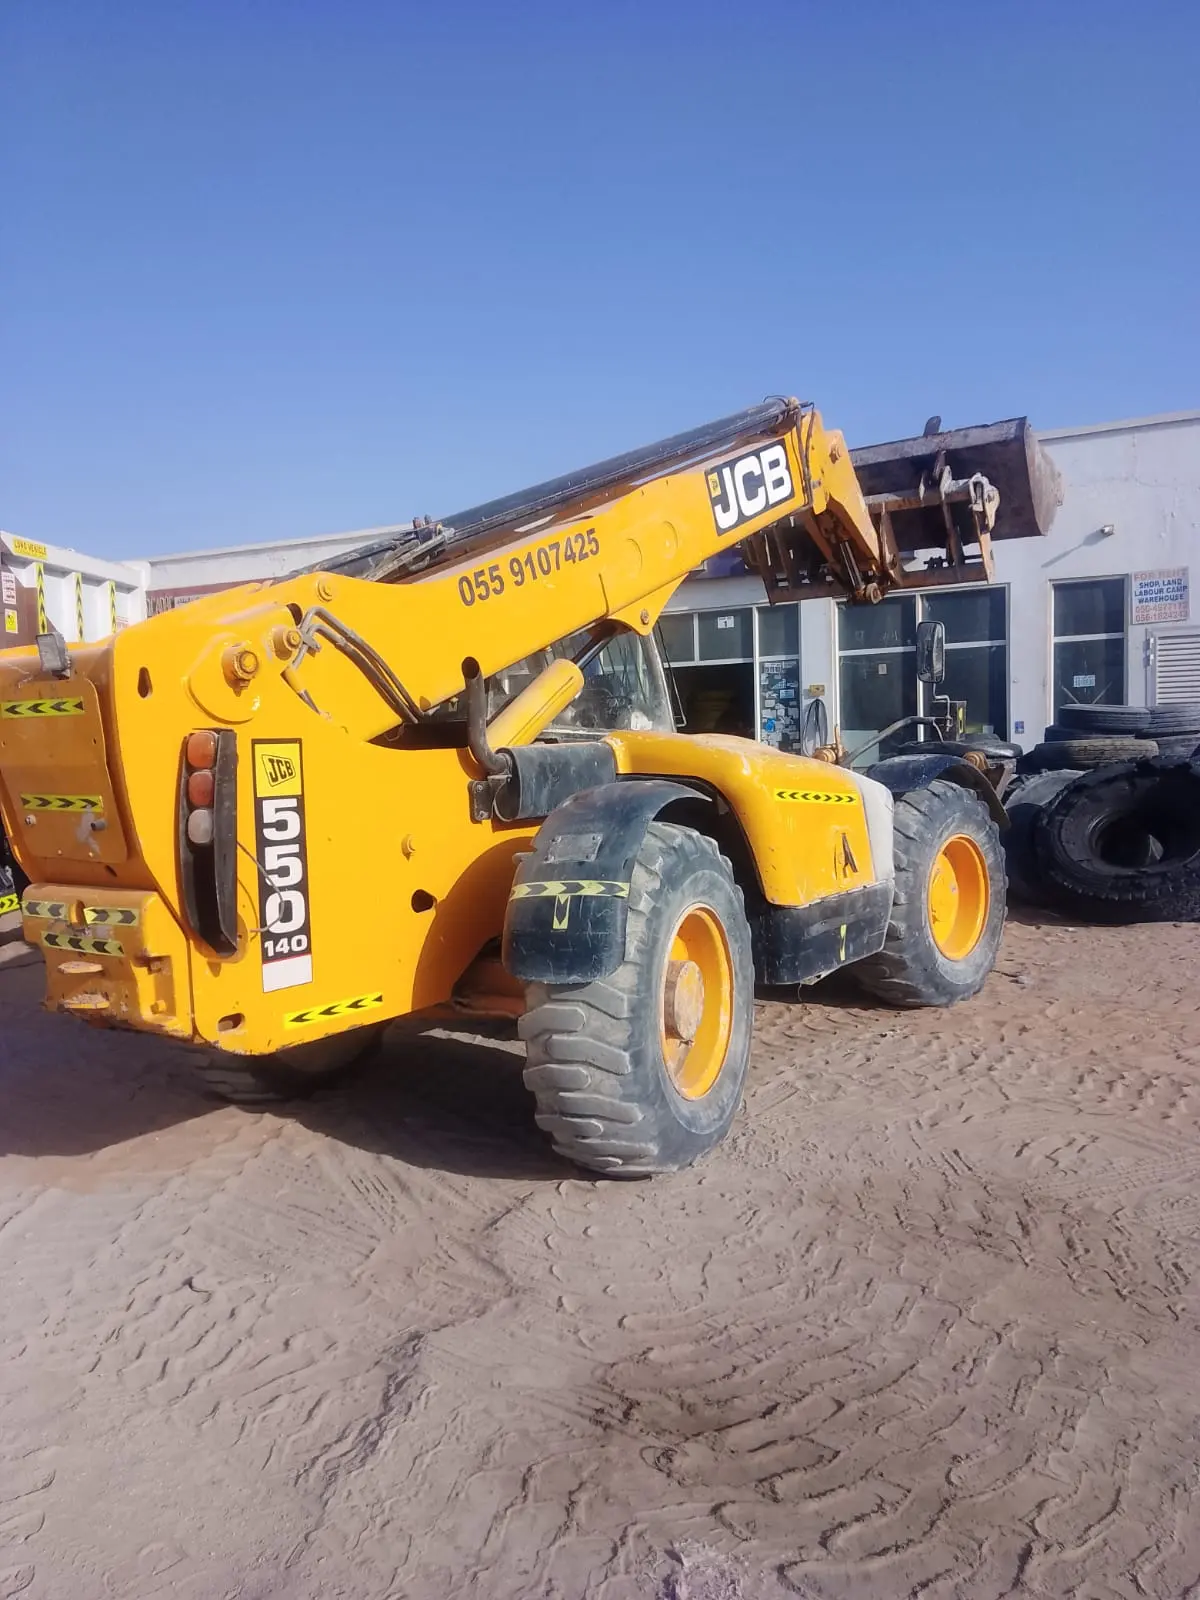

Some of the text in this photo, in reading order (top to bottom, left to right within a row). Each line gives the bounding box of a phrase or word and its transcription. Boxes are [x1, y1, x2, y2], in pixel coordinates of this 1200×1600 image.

[714, 445, 791, 529] JCB
[458, 528, 600, 606] 055 9107425
[1135, 588, 1164, 597] LABOUR
[1138, 594, 1184, 604] WAREHOUSE
[267, 757, 295, 783] JCB
[262, 798, 306, 934] 550
[264, 934, 308, 957] 140
